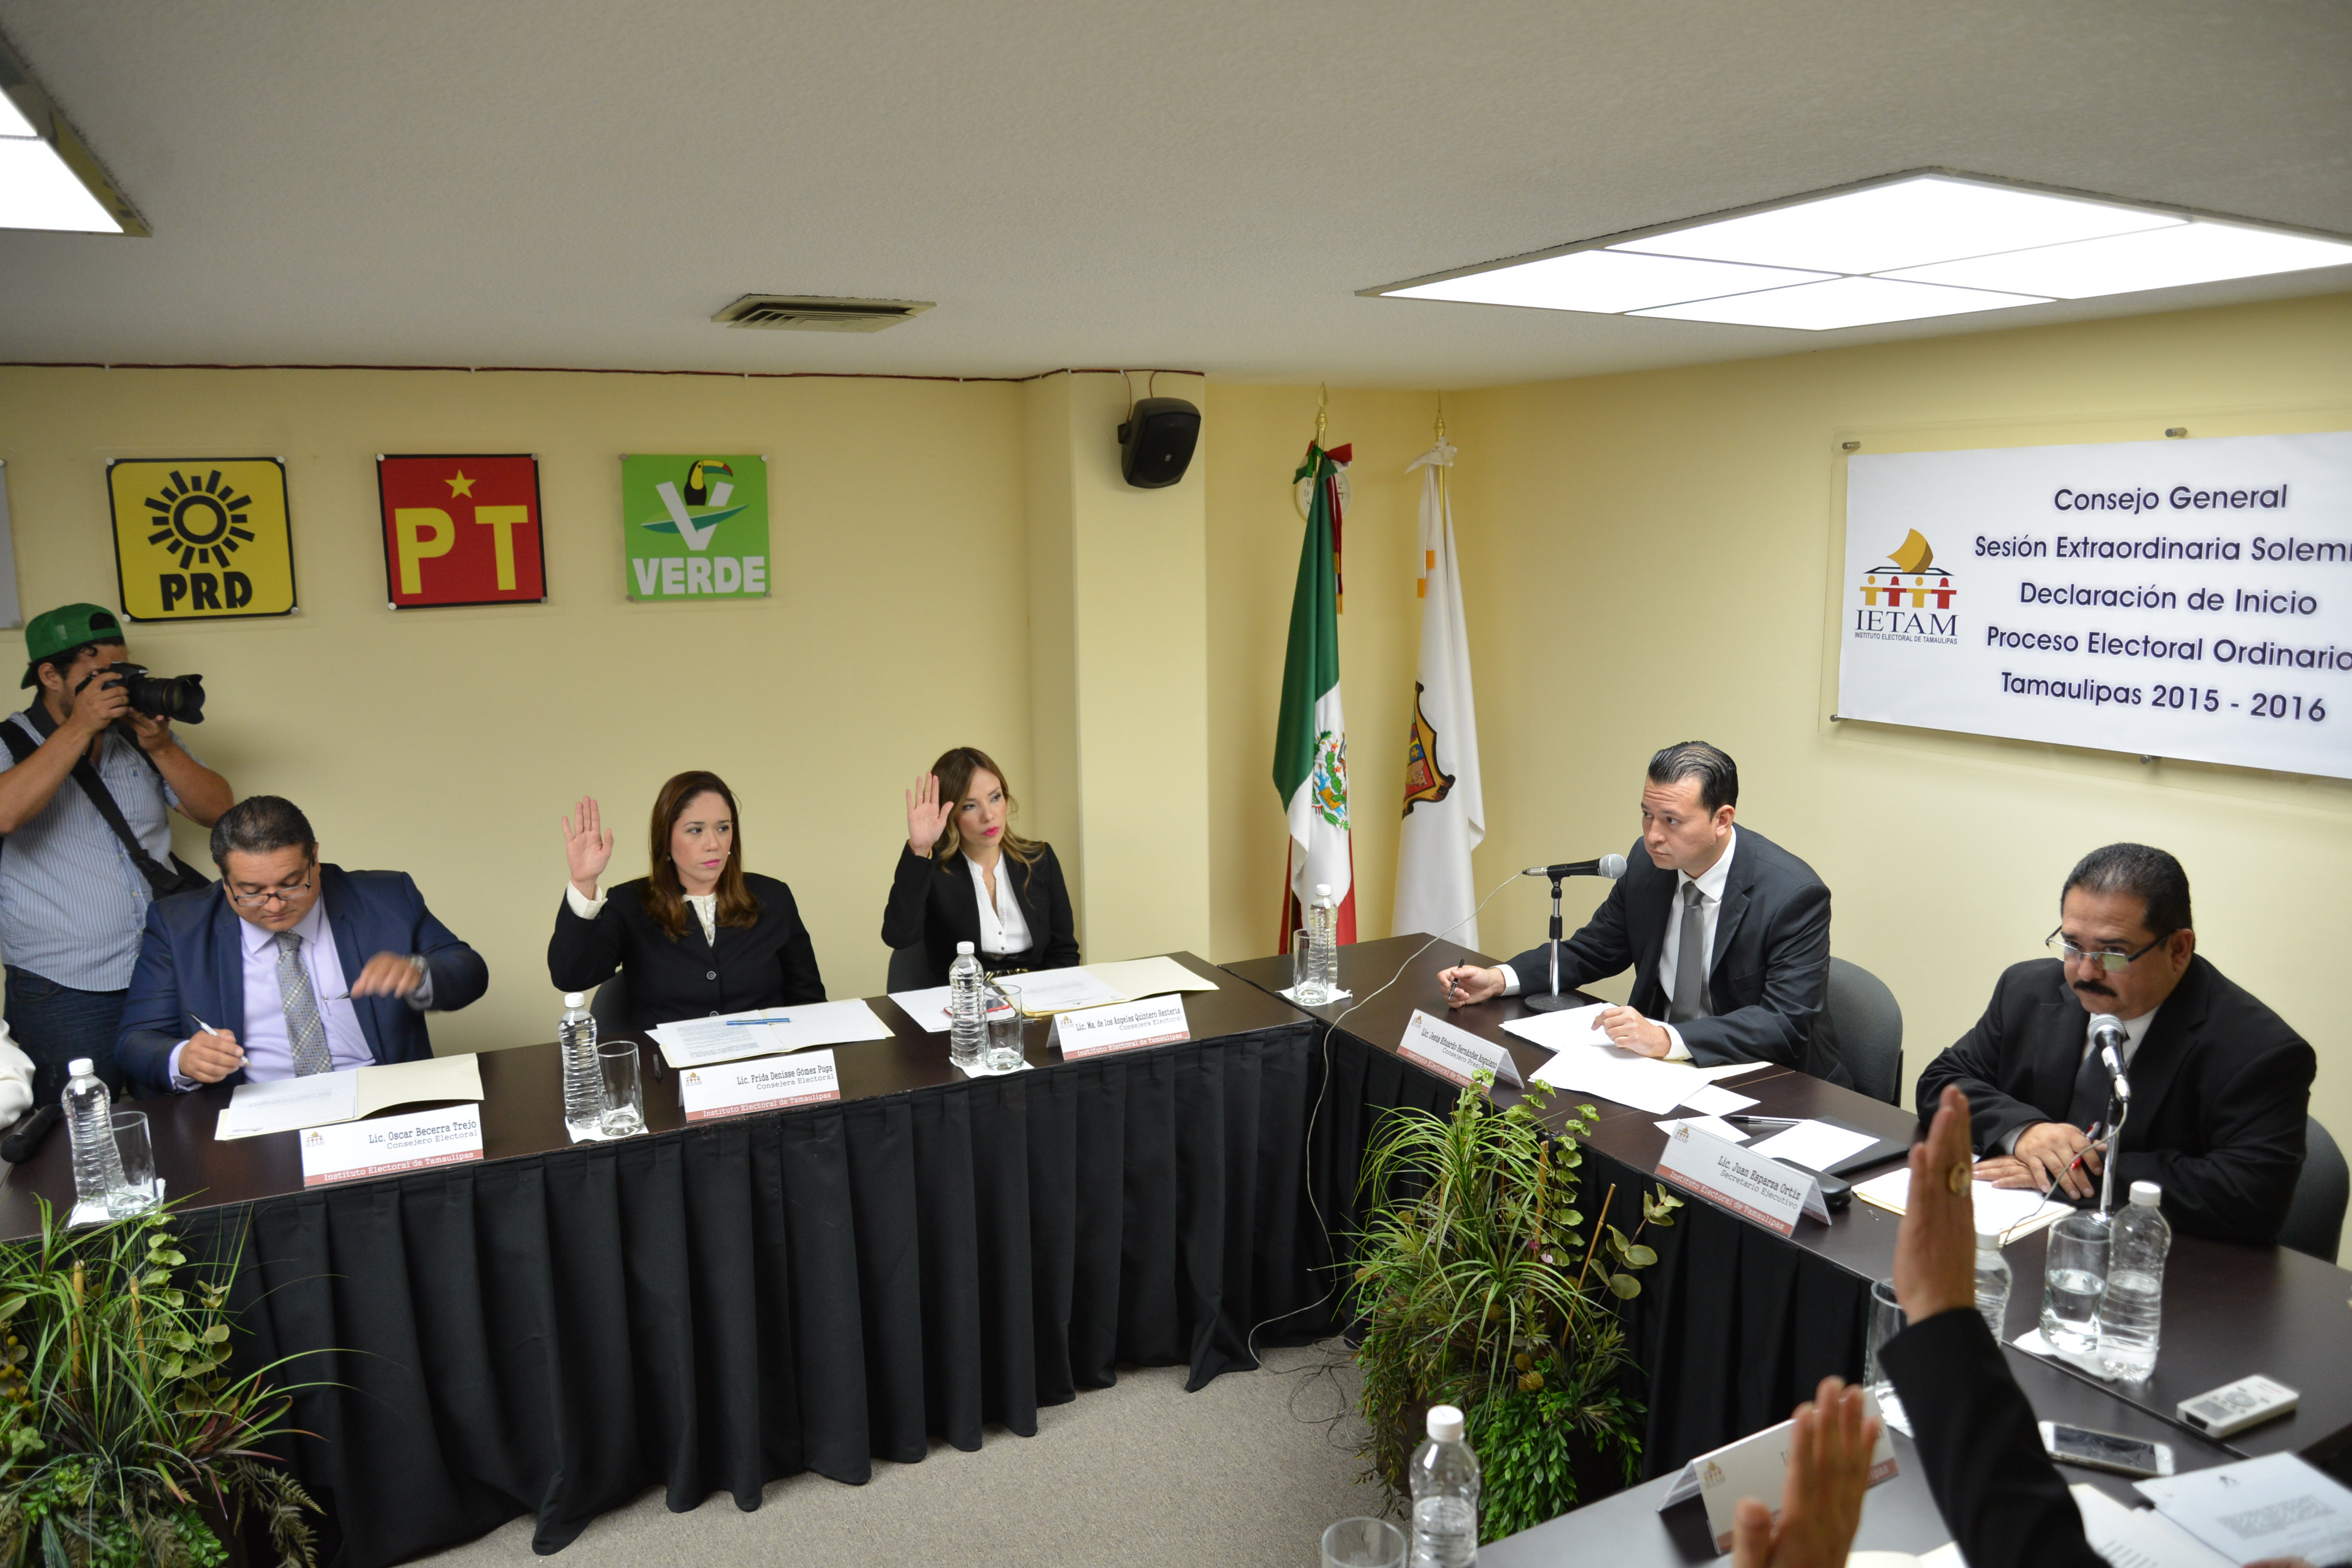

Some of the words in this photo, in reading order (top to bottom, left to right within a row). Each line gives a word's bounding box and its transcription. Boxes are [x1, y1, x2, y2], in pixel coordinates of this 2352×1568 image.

[2054, 487, 2160, 514] Consejo
[2169, 484, 2287, 509] General
[395, 505, 529, 595] PT
[1975, 534, 2047, 557] Sesión
[2056, 536, 2240, 561] Extraordinaria
[2251, 537, 2352, 562] Solem
[632, 555, 766, 595] VERDE
[160, 571, 253, 611] PRD
[2020, 582, 2176, 609] Declaración
[2187, 588, 2224, 611] de
[2235, 589, 2317, 615] Inicio
[1855, 609, 1959, 636] IETAM
[1882, 633, 1913, 642] ELECTORAL
[1924, 636, 1957, 645] TAMAULIPAS
[1987, 626, 2079, 652] Proceso
[2088, 632, 2202, 660] Electoral
[2213, 639, 2352, 671] Ordinario
[2002, 672, 2142, 706] Tamaulipas
[2151, 684, 2219, 712] 2015
[2250, 693, 2325, 722] 2016
[1119, 1021, 1151, 1031] Consejera
[1153, 1015, 1183, 1025] Electoral
[1135, 1012, 1157, 1022] Quintero
[1077, 1047, 1107, 1056] Instituto
[1108, 1040, 1139, 1050] Electoral
[1148, 1034, 1182, 1044] Tamaulipas
[1440, 1037, 1457, 1050] Eduardo
[1478, 1054, 1498, 1069] Anguiano
[1442, 1047, 1466, 1062] Consejero
[737, 1076, 750, 1085] Lic.
[751, 1073, 769, 1083] Frida
[770, 1070, 795, 1080] Denisse
[796, 1067, 816, 1076] Gómez
[817, 1065, 833, 1074] Puga
[1407, 1050, 1427, 1064] Instituto
[1427, 1061, 1450, 1075] Electoral
[756, 1080, 795, 1089] Consejera
[798, 1073, 834, 1084] Electoral
[703, 1106, 739, 1117] Instituto
[740, 1100, 777, 1111] Electoral
[789, 1093, 831, 1104] Tamaulipas
[369, 1134, 386, 1144] Lic.
[388, 1130, 413, 1141] Oscar
[416, 1125, 450, 1136] Becerra
[452, 1120, 476, 1131] Trejo
[387, 1138, 432, 1149] Consejero
[435, 1130, 478, 1142] Electoral
[324, 1169, 366, 1181] Instituto
[368, 1160, 410, 1174] Electoral
[425, 1152, 474, 1164] Tamaulipas
[1718, 1156, 1730, 1170] Lic.
[1732, 1162, 1749, 1178] Juan
[1750, 1170, 1779, 1191] Esparza
[1780, 1183, 1801, 1200] Ortiz
[1670, 1171, 1699, 1189] Instituto
[1700, 1185, 1733, 1206] Electoral
[1734, 1202, 1743, 1210] de
[1744, 1206, 1784, 1230] Tamaulipas
[1720, 1169, 1759, 1192] Secretario
[1761, 1187, 1798, 1209] Ejecutivo
